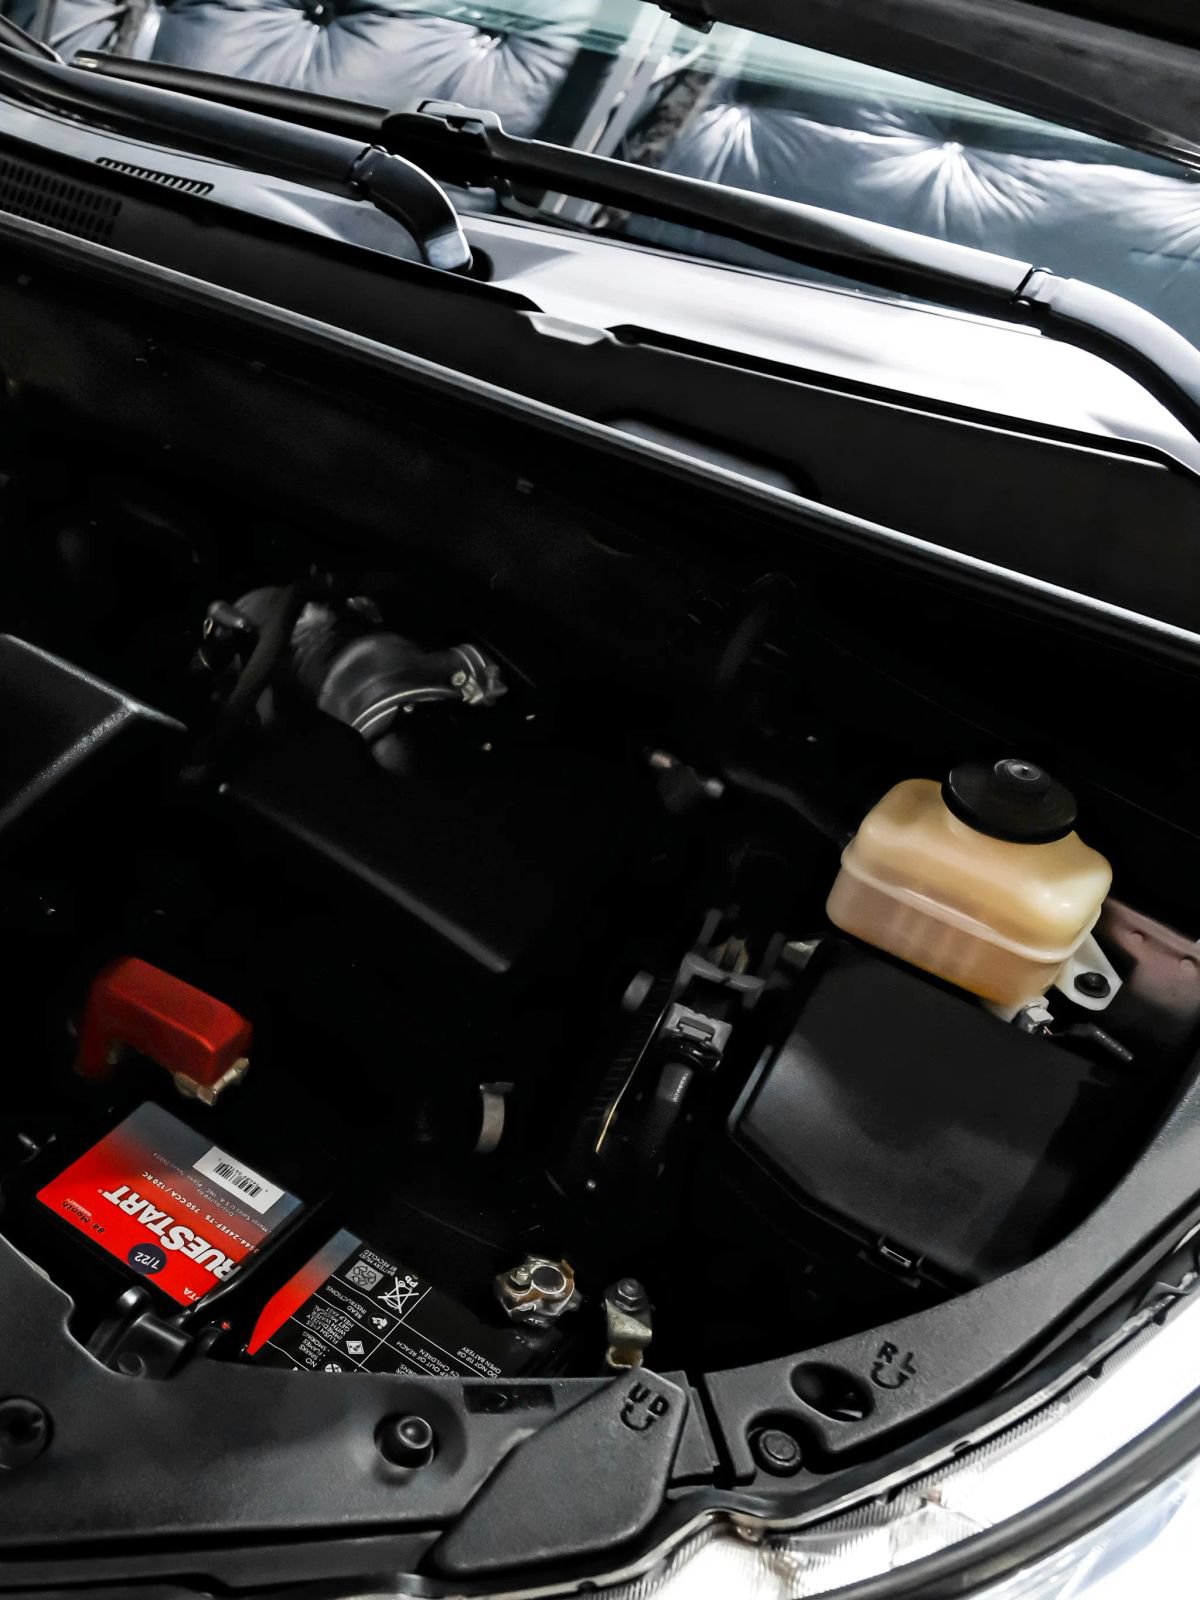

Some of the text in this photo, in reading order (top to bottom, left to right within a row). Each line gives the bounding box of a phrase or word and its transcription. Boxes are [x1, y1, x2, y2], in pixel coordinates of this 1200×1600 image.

[142, 1171, 154, 1181] RC
[153, 1179, 165, 1189] 120
[171, 1190, 187, 1204] CCA
[62, 1200, 90, 1223] Month
[186, 1202, 200, 1214] 750
[359, 1253, 395, 1276] BATTERY MUST
[364, 1250, 390, 1267] RECYCLED
[405, 1276, 418, 1288] Pb
[326, 1286, 367, 1314] INSTRUCTIONS
[315, 1305, 350, 1332] GET MEDICAL
[326, 1308, 354, 1328] HELP FAST
[346, 1305, 362, 1319] READ
[306, 1314, 342, 1340] IMMEDIATELY
[312, 1311, 345, 1335] WITH WATER
[302, 1332, 327, 1351] SMOKING
[320, 1329, 338, 1344] FLUSH
[299, 1344, 318, 1360] SPARKS
[303, 1339, 323, 1355] FLAMES
[396, 1341, 417, 1356] REACH
[306, 1358, 317, 1367] NO
[420, 1349, 450, 1371] CHILDREN
[462, 1347, 501, 1374] OPEN BATTERY
[877, 1341, 916, 1374] R L
[426, 1362, 440, 1372] OUT
[474, 1363, 487, 1372] NOT
[487, 1370, 497, 1378] DO
[628, 1382, 669, 1417] U D
